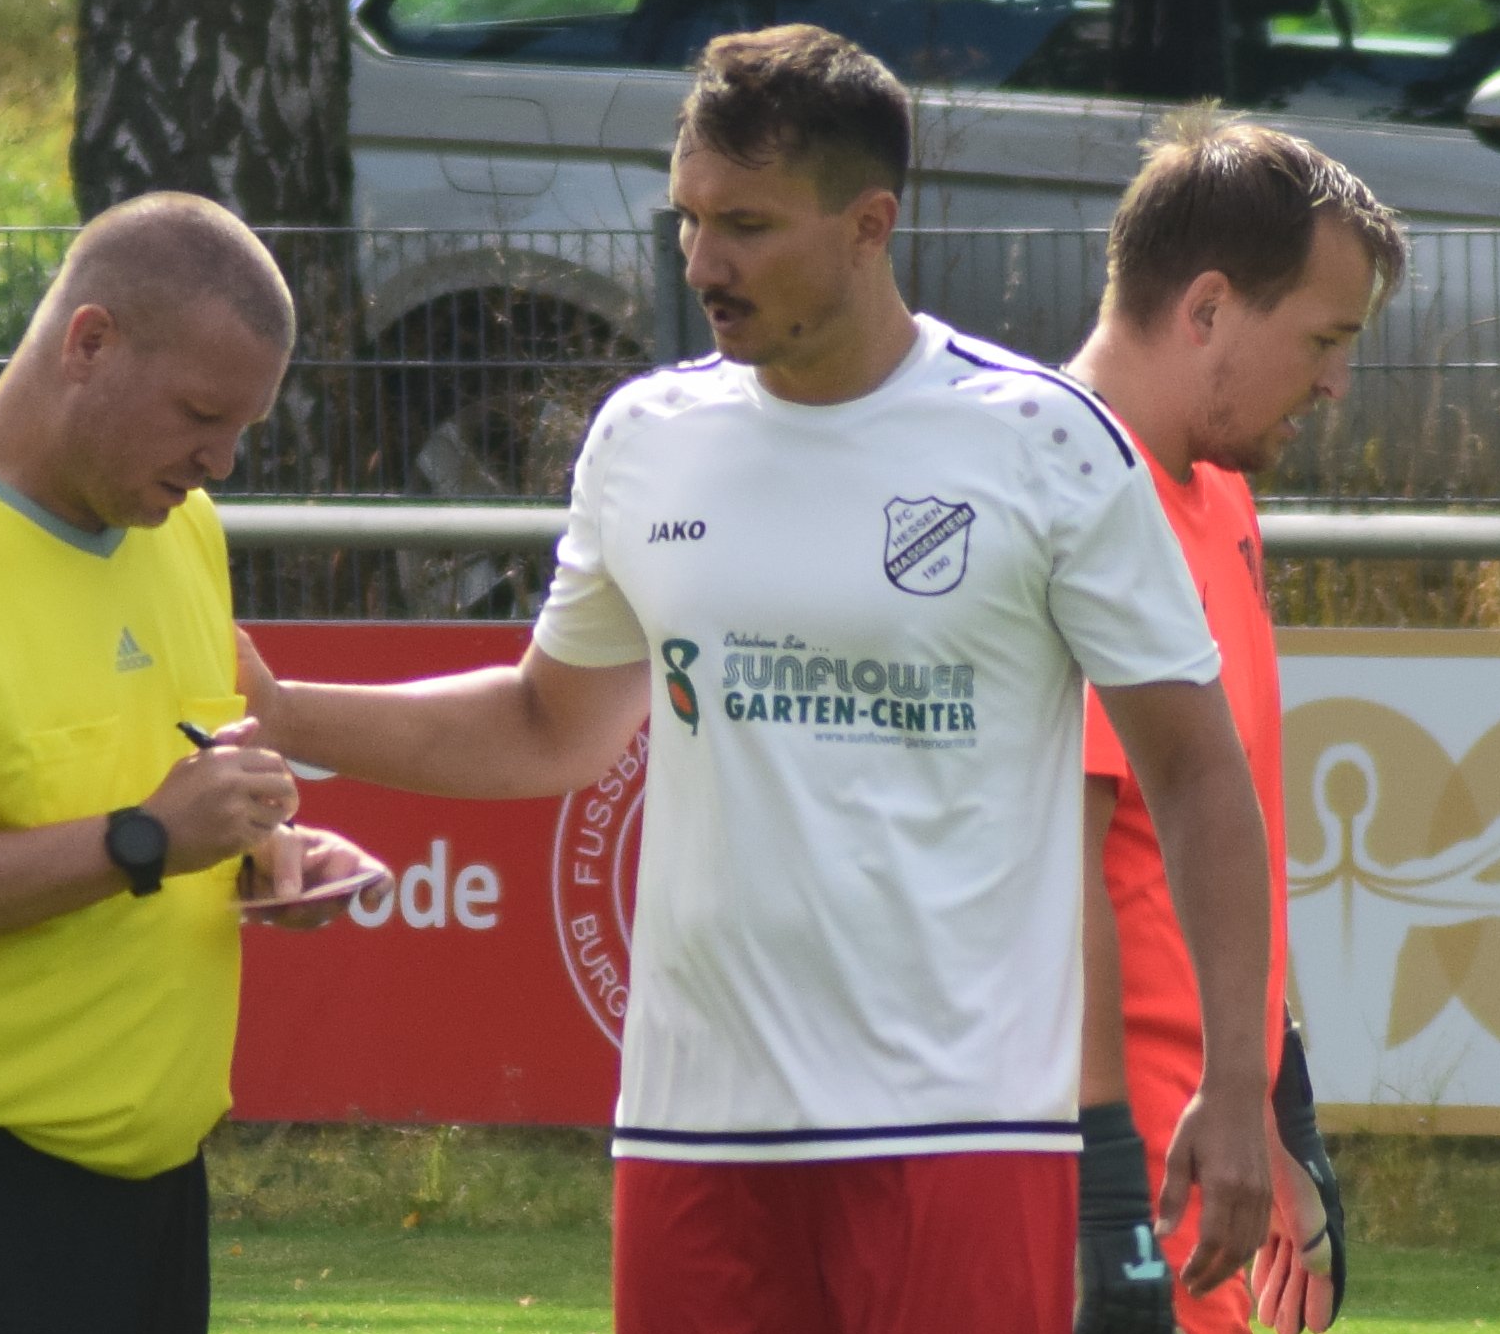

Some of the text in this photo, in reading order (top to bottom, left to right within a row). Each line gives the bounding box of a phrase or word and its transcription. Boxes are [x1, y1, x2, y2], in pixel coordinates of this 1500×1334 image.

[648, 520, 706, 543] JAKO
[892, 505, 943, 549] HESSEN
[722, 652, 975, 700] SUNFLOWER
[724, 692, 977, 732] GARTEN-CENTER
